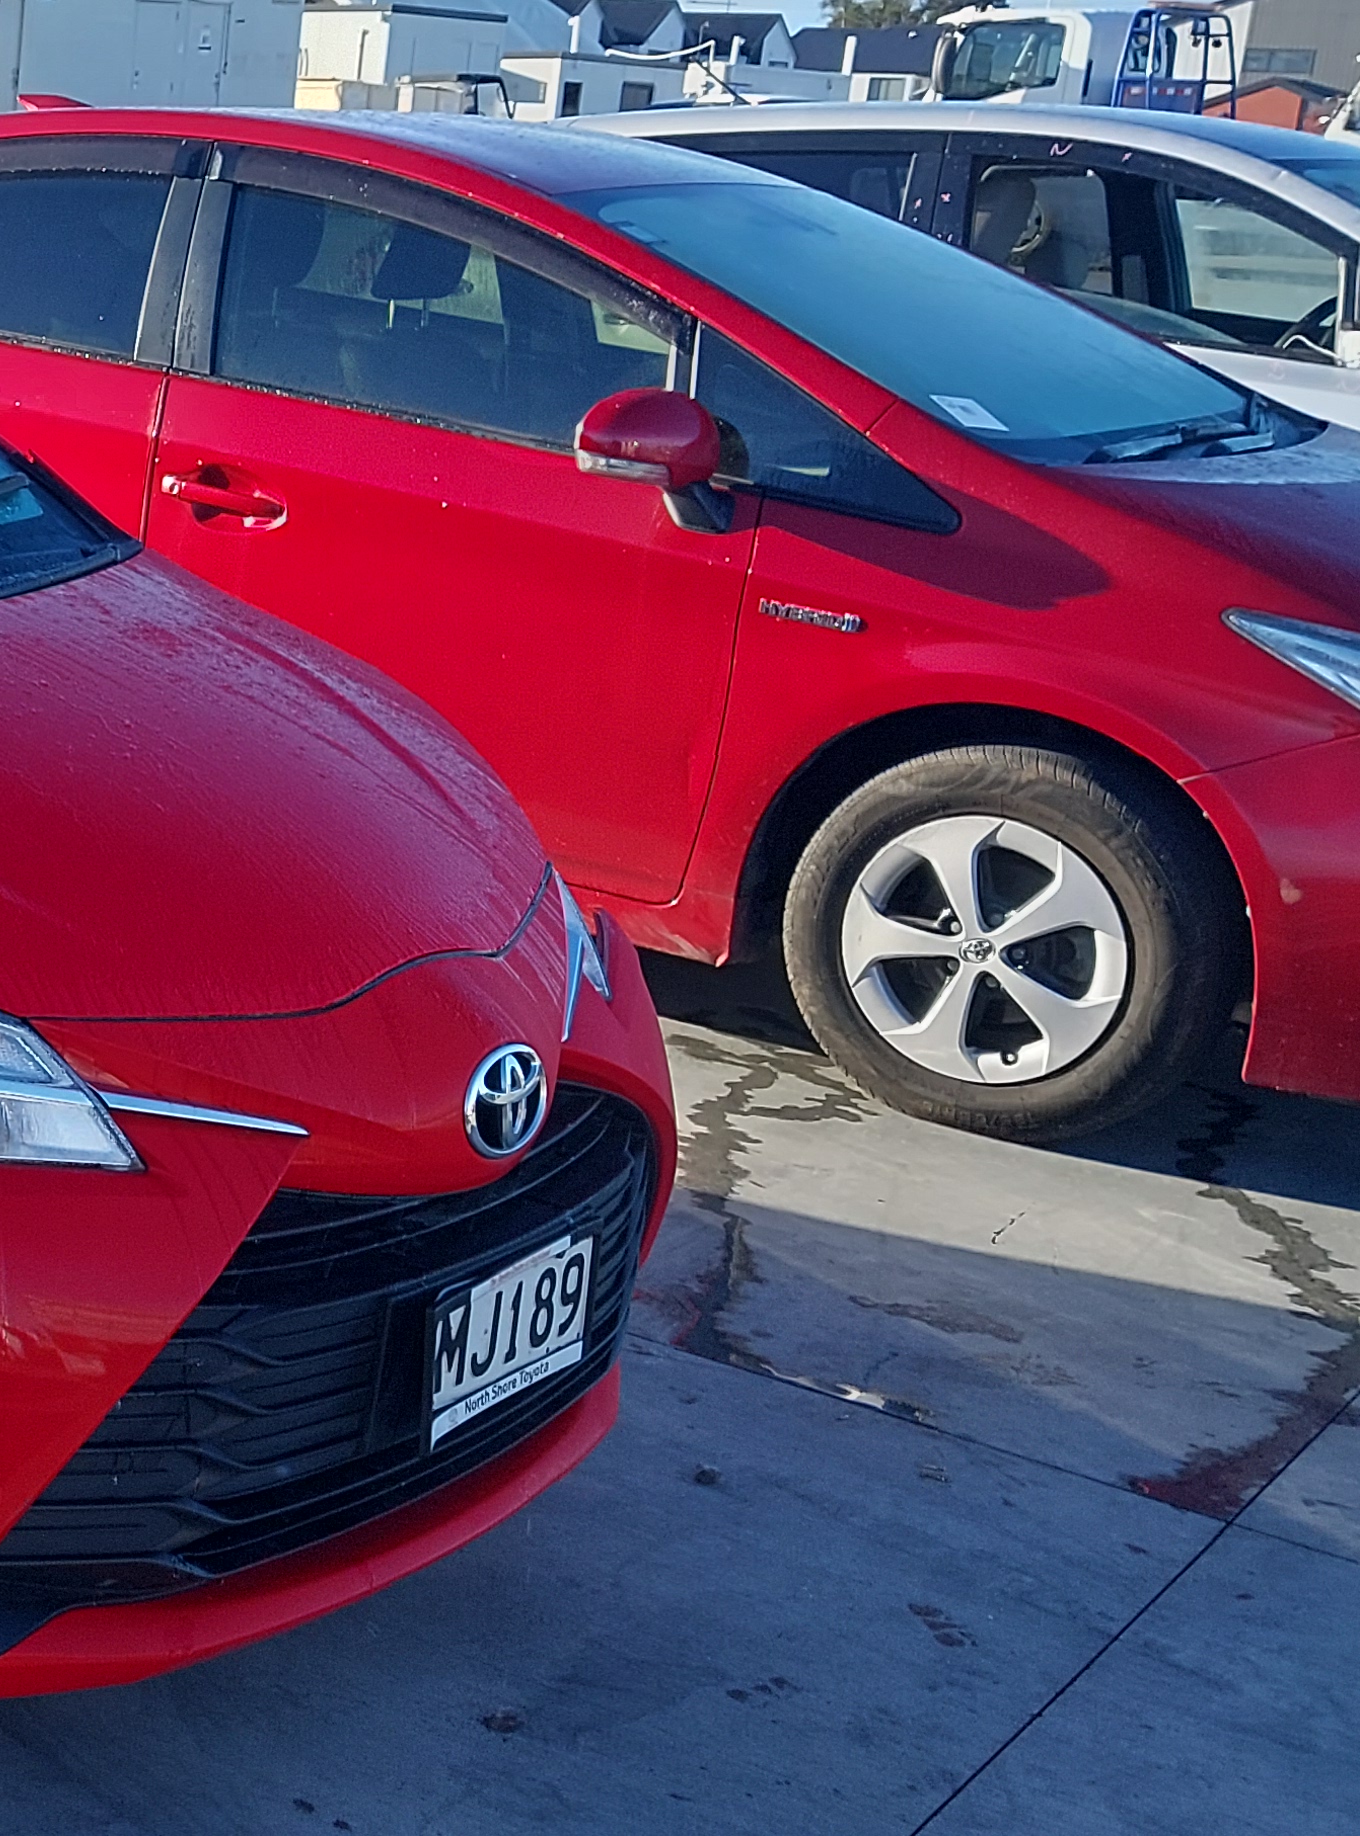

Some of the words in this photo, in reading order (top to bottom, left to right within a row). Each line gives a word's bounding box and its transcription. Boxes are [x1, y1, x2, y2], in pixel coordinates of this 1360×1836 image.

[759, 597, 843, 631] HYBRID
[464, 1392, 490, 1415] North
[491, 1378, 517, 1402] Shore
[519, 1361, 550, 1384] Toyota
